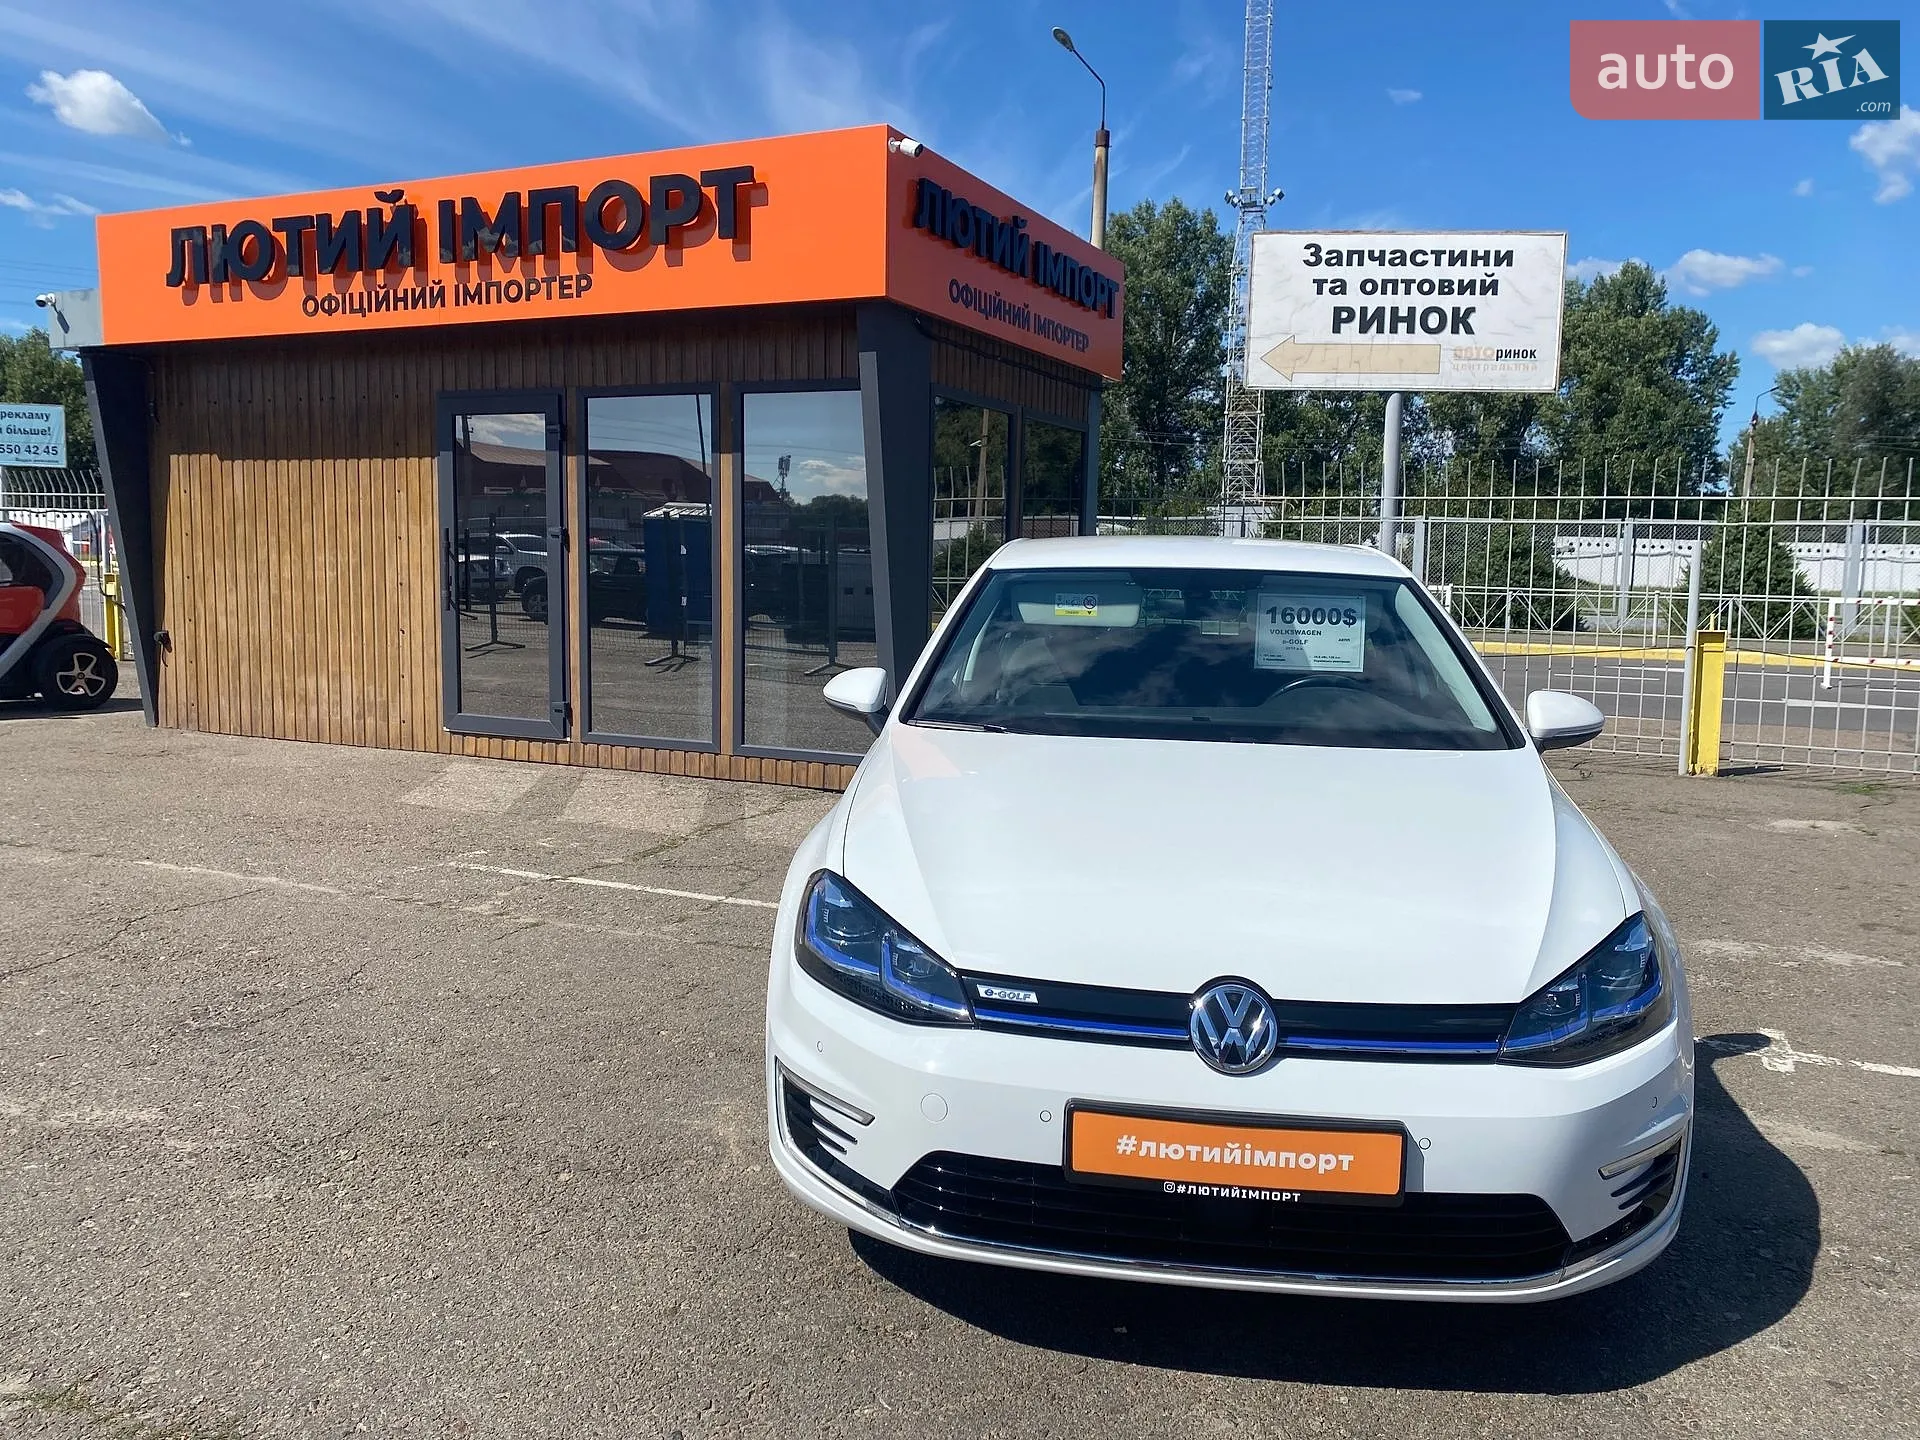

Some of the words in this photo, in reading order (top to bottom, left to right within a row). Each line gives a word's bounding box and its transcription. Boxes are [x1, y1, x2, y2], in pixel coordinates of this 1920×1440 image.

[166, 189, 416, 287] ЛЮТИЙ
[438, 165, 755, 263] ІМПОРТ
[914, 177, 1030, 278] ЛЮТИЙ
[1034, 240, 1120, 319] ІМПОРТ
[1302, 243, 1514, 267] Запчастини
[302, 280, 446, 317] ОФІЦІЙНИЙ
[454, 273, 593, 307] ІМПОРТЕР
[1312, 277, 1347, 296] та
[1359, 272, 1499, 296] оптовий
[949, 278, 1031, 332] ОФІЦІЙНИЙ
[1033, 312, 1089, 352] ІМПОРТЕР
[1331, 305, 1476, 335] РИНОК
[0, 411, 51, 421] рекламу
[6, 424, 51, 436] більше!
[24, 445, 39, 455] 42
[43, 446, 58, 456] 45
[1266, 606, 1357, 628] 16000$
[1116, 1134, 1354, 1174] #лютийімпорт
